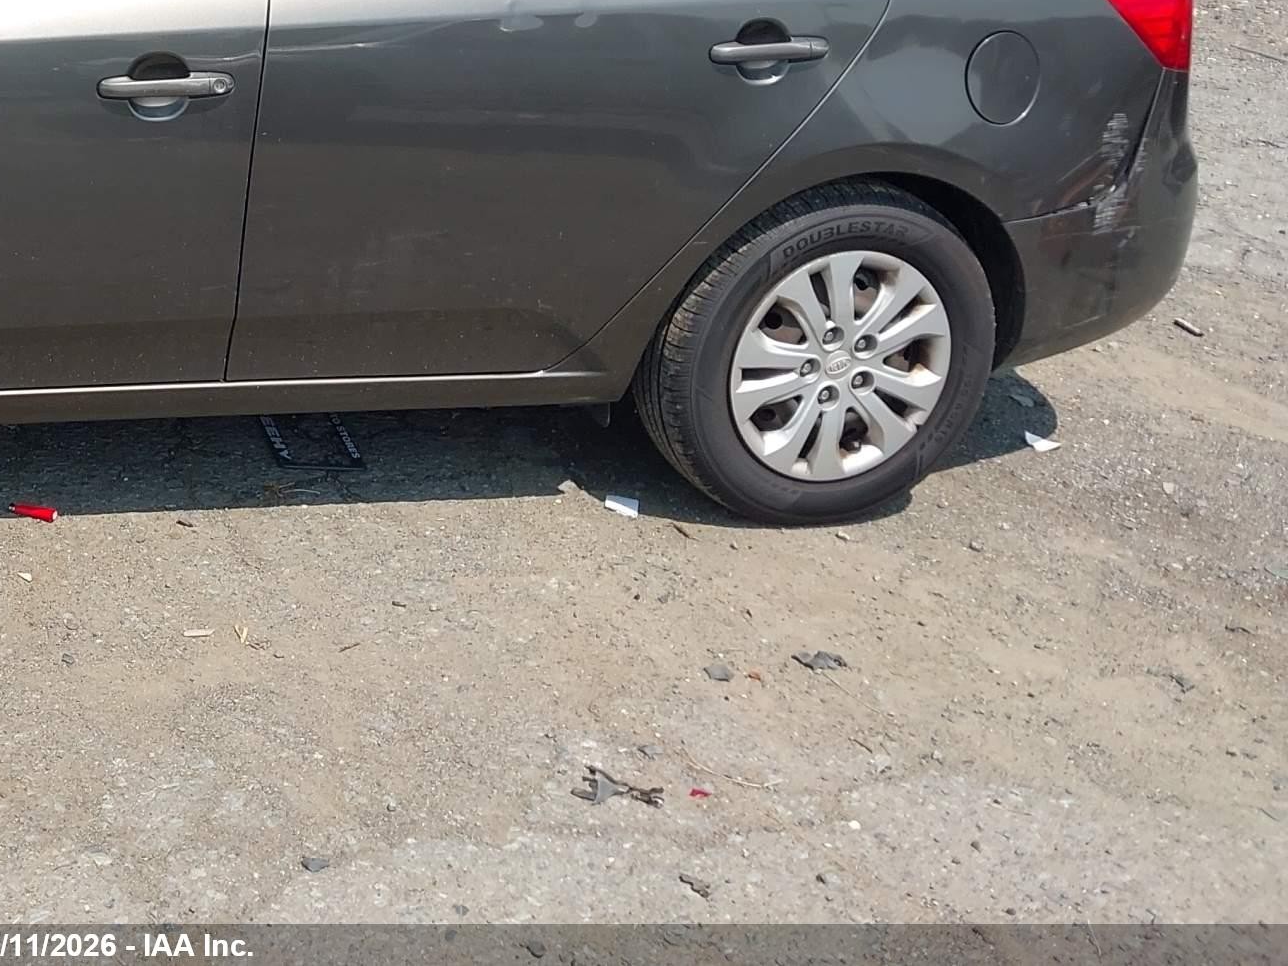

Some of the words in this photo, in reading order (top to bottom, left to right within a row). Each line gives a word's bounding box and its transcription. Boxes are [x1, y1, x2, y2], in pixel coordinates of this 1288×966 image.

[782, 220, 909, 258] DOUBLESTAR
[260, 416, 292, 460] EEHY
[336, 425, 361, 459] STORES
